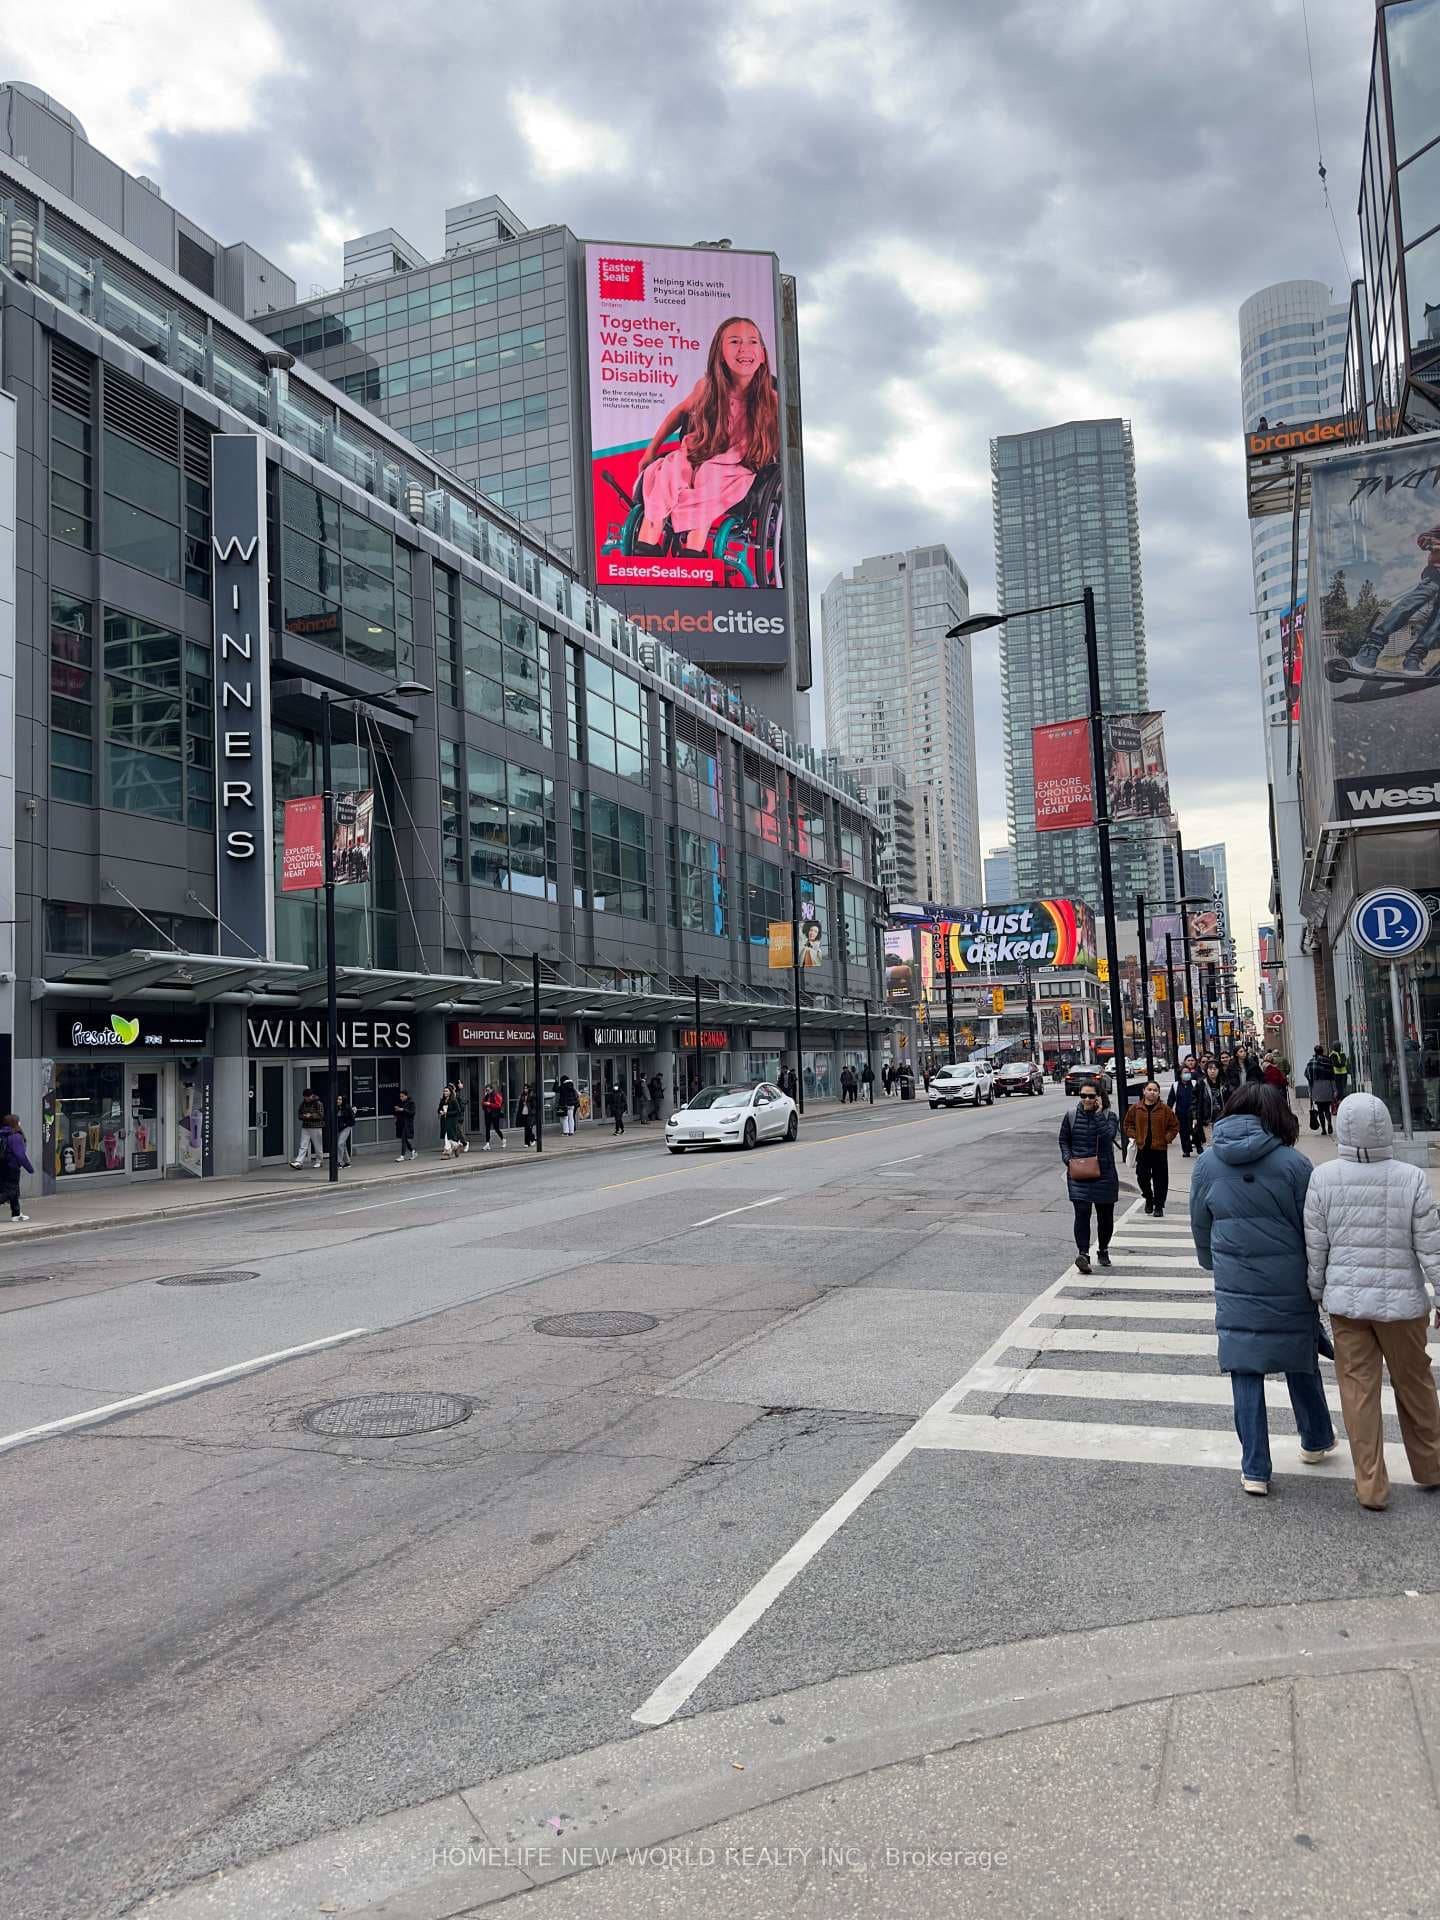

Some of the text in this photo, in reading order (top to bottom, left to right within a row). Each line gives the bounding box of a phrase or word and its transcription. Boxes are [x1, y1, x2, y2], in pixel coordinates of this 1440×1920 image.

[602, 262, 636, 272] Easter
[602, 272, 630, 282] Seals
[653, 278, 684, 287] Helping
[653, 287, 731, 299] Physical Disabilities
[654, 297, 686, 305] Succeed
[600, 314, 680, 334] Together,
[600, 332, 700, 350] We See The
[601, 350, 673, 368] Ability in
[602, 368, 679, 387] Disability
[609, 564, 714, 582] EasterSeals.org
[629, 609, 785, 635] andedcities
[211, 535, 258, 859] WINNERS
[1037, 776, 1081, 790] EXPLORE
[1035, 784, 1091, 799] TORONTO'S
[1043, 793, 1093, 806] CULTURAL
[1037, 804, 1070, 816] HEART
[285, 845, 315, 856] EXPLORE
[283, 852, 321, 864] TORONTO'S
[288, 859, 323, 870] CULTURAL
[284, 868, 306, 878] HEART
[975, 909, 1034, 943] just
[1372, 906, 1402, 939] P
[966, 932, 1055, 964] asked.
[71, 1021, 126, 1047] Presotea
[247, 1018, 412, 1049] WINNERS
[462, 1028, 564, 1041] CHIPOTLE MEXICA GRILL
